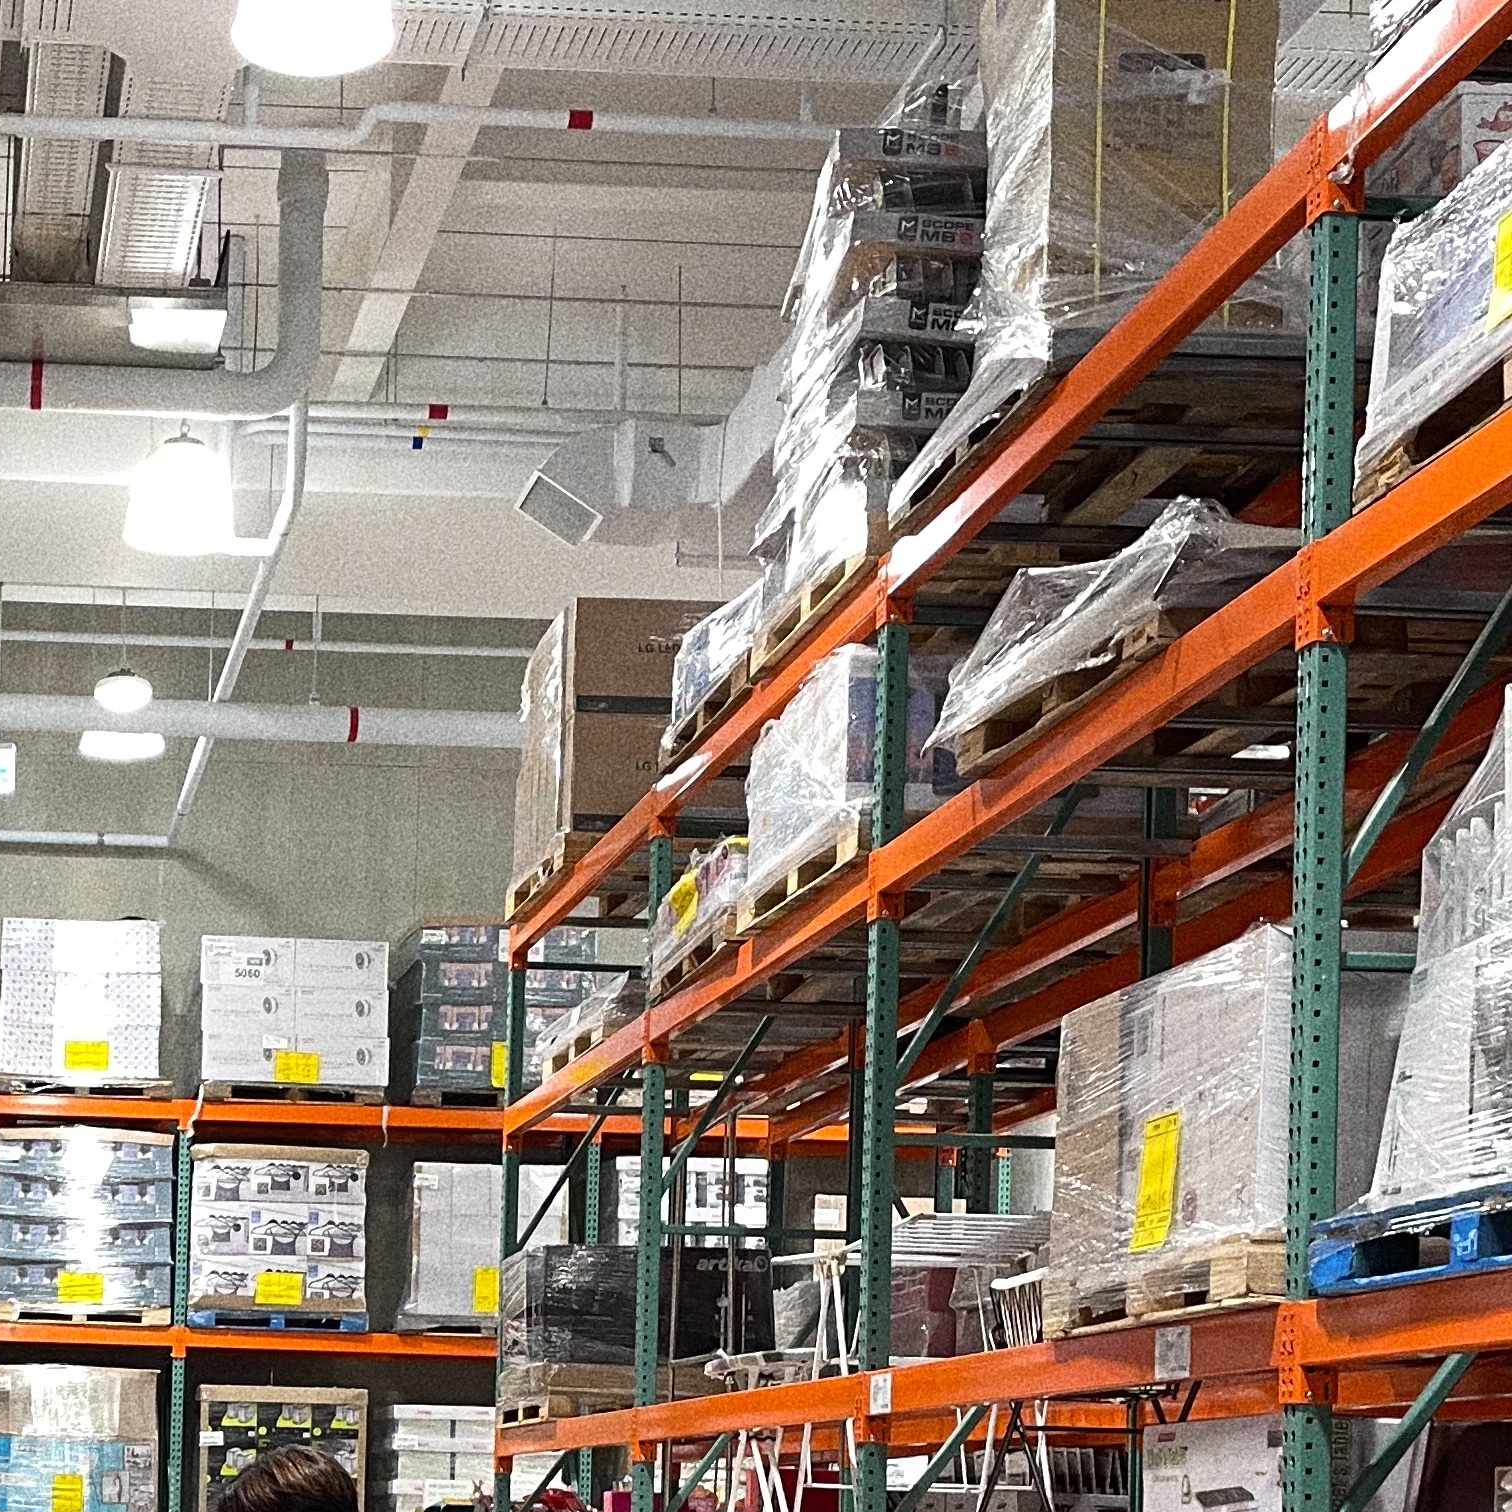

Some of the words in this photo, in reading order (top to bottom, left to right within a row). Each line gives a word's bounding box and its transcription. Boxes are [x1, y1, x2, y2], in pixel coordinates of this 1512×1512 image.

[638, 643, 654, 653] LG
[635, 760, 652, 772] LG
[234, 968, 261, 979] 5060
[696, 1257, 754, 1272] artka
